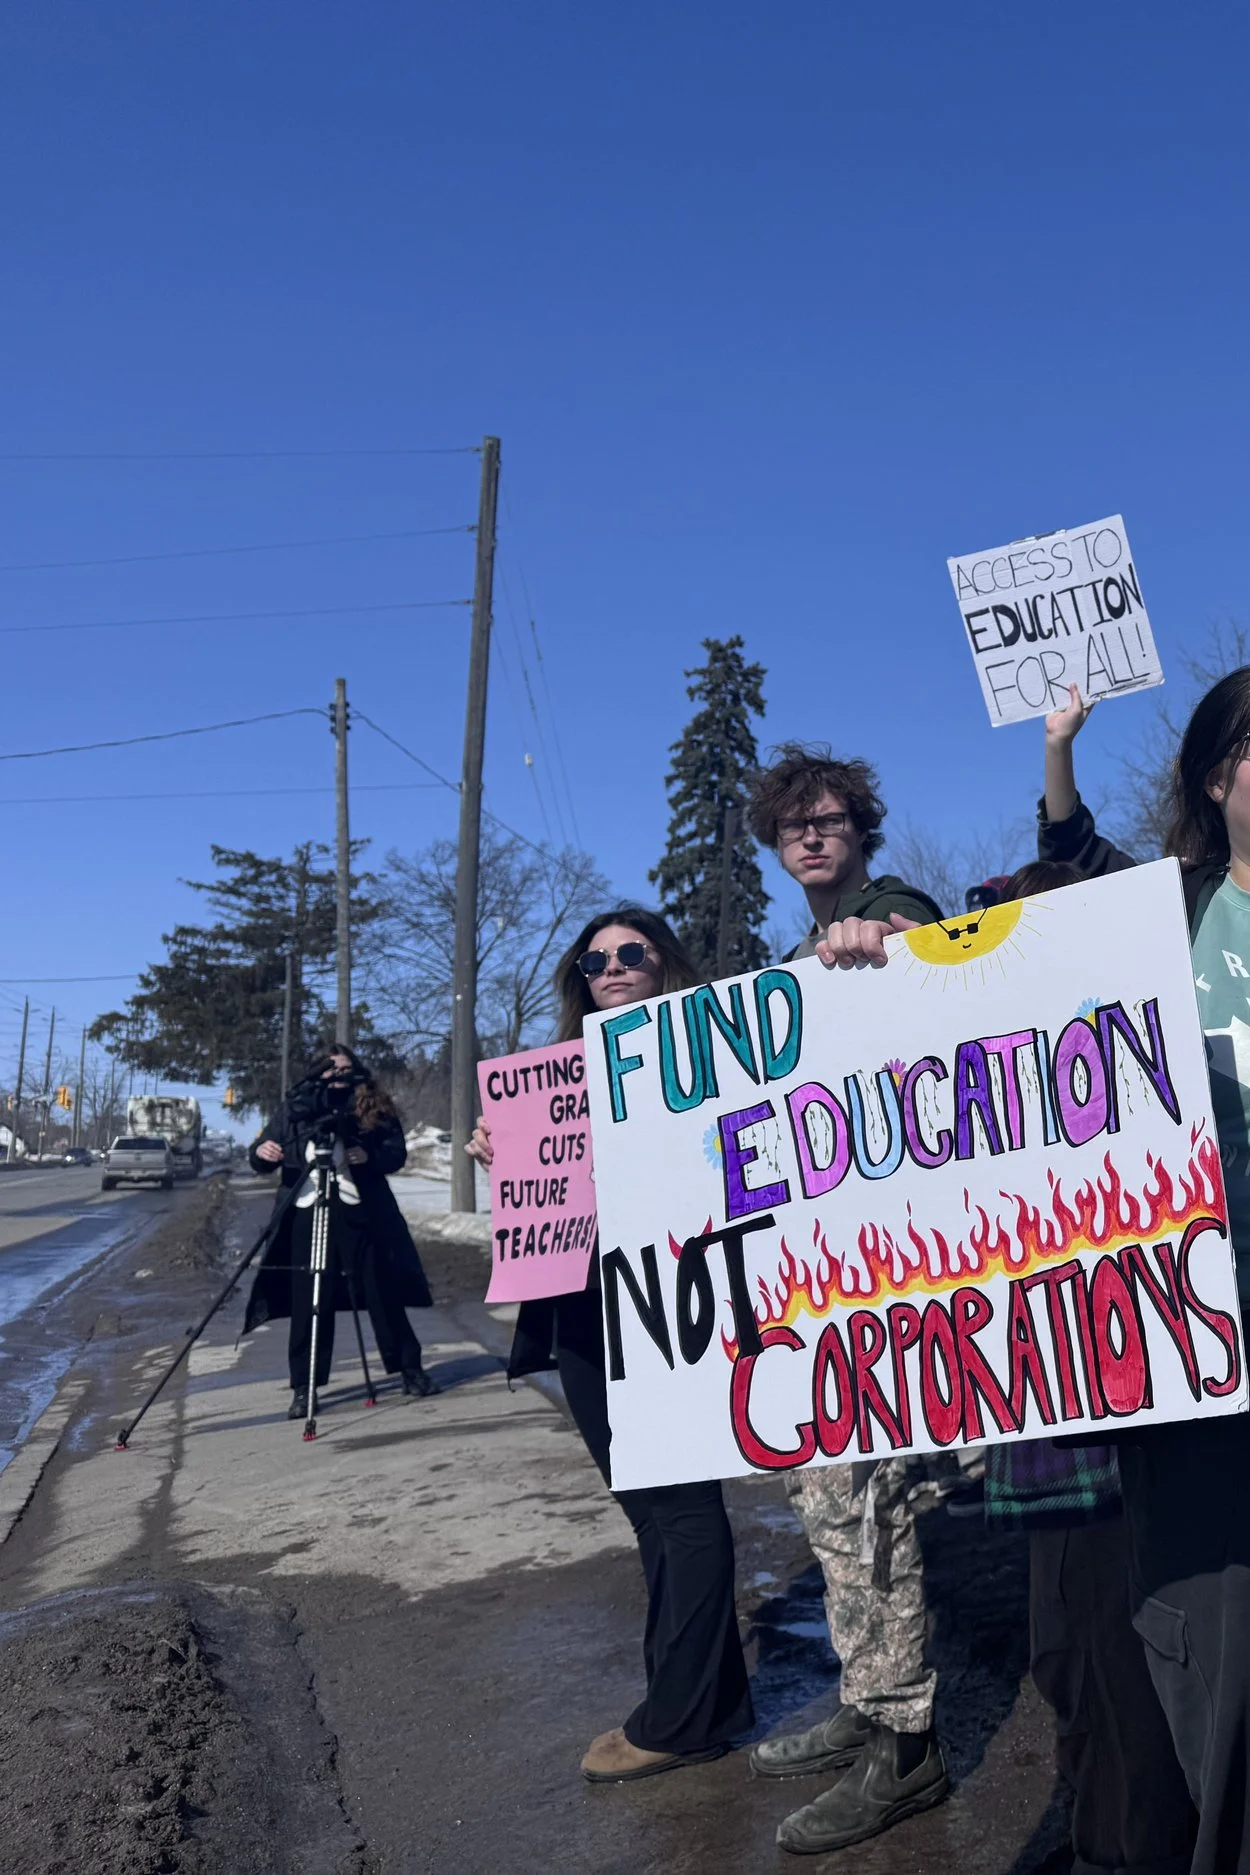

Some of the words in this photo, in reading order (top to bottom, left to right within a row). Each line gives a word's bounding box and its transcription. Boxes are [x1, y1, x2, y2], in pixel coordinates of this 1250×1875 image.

[956, 541, 1073, 601] ACCESS
[1072, 528, 1122, 573] TO
[964, 562, 1144, 655] EDUCATION
[985, 650, 1071, 717] FOR
[1086, 622, 1151, 695] ALL!
[486, 1054, 585, 1101] CUTTING
[600, 968, 802, 1123] FUND
[538, 1132, 586, 1166] CUTS
[716, 996, 1183, 1221] EDUCATION
[495, 1210, 598, 1263] TEACHERS!
[499, 1176, 569, 1210] FUTURE
[600, 1213, 776, 1382] NOT
[727, 1216, 1243, 1472] CORPORATIONS
